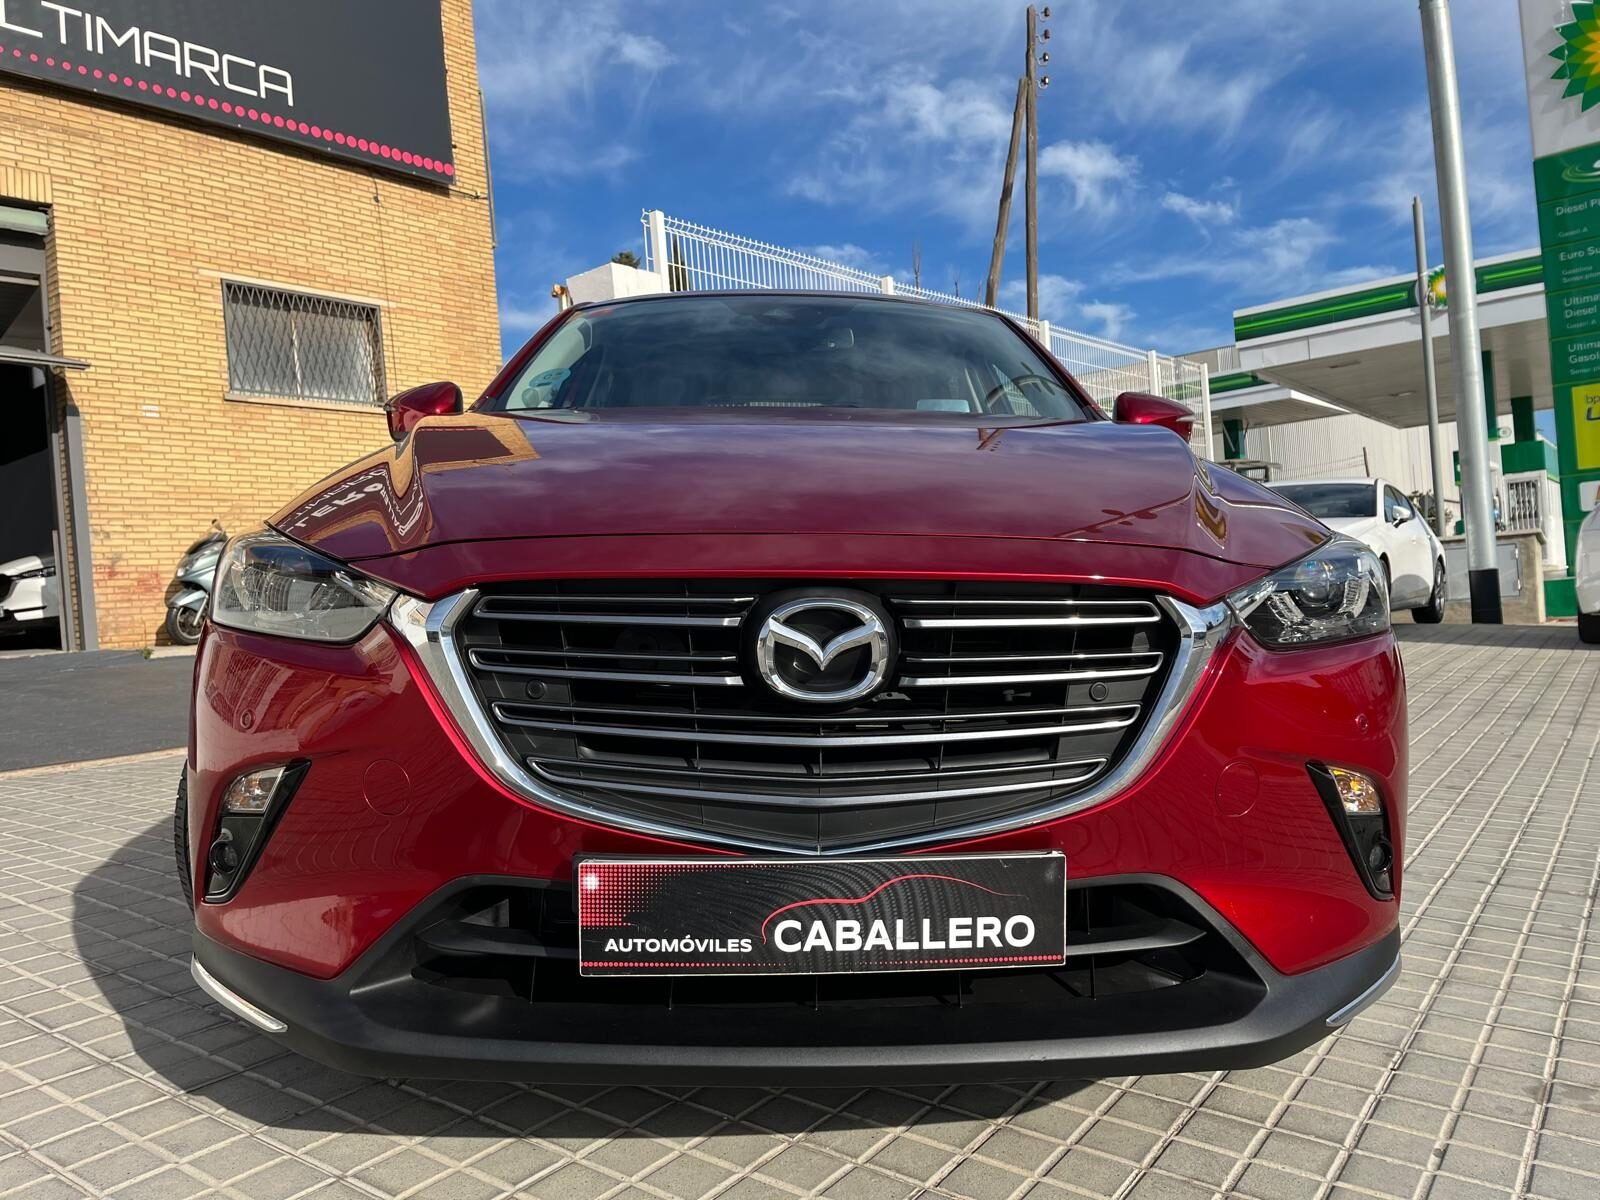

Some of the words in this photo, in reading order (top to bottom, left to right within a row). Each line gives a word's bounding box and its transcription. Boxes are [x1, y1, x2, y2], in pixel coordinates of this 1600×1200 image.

[1556, 201, 1587, 216] Diesel
[1560, 250, 1585, 261] Euro
[1565, 304, 1597, 319] Diesel
[604, 934, 753, 954] AUTOMÓVILES
[773, 914, 1036, 952] CABALLERO
